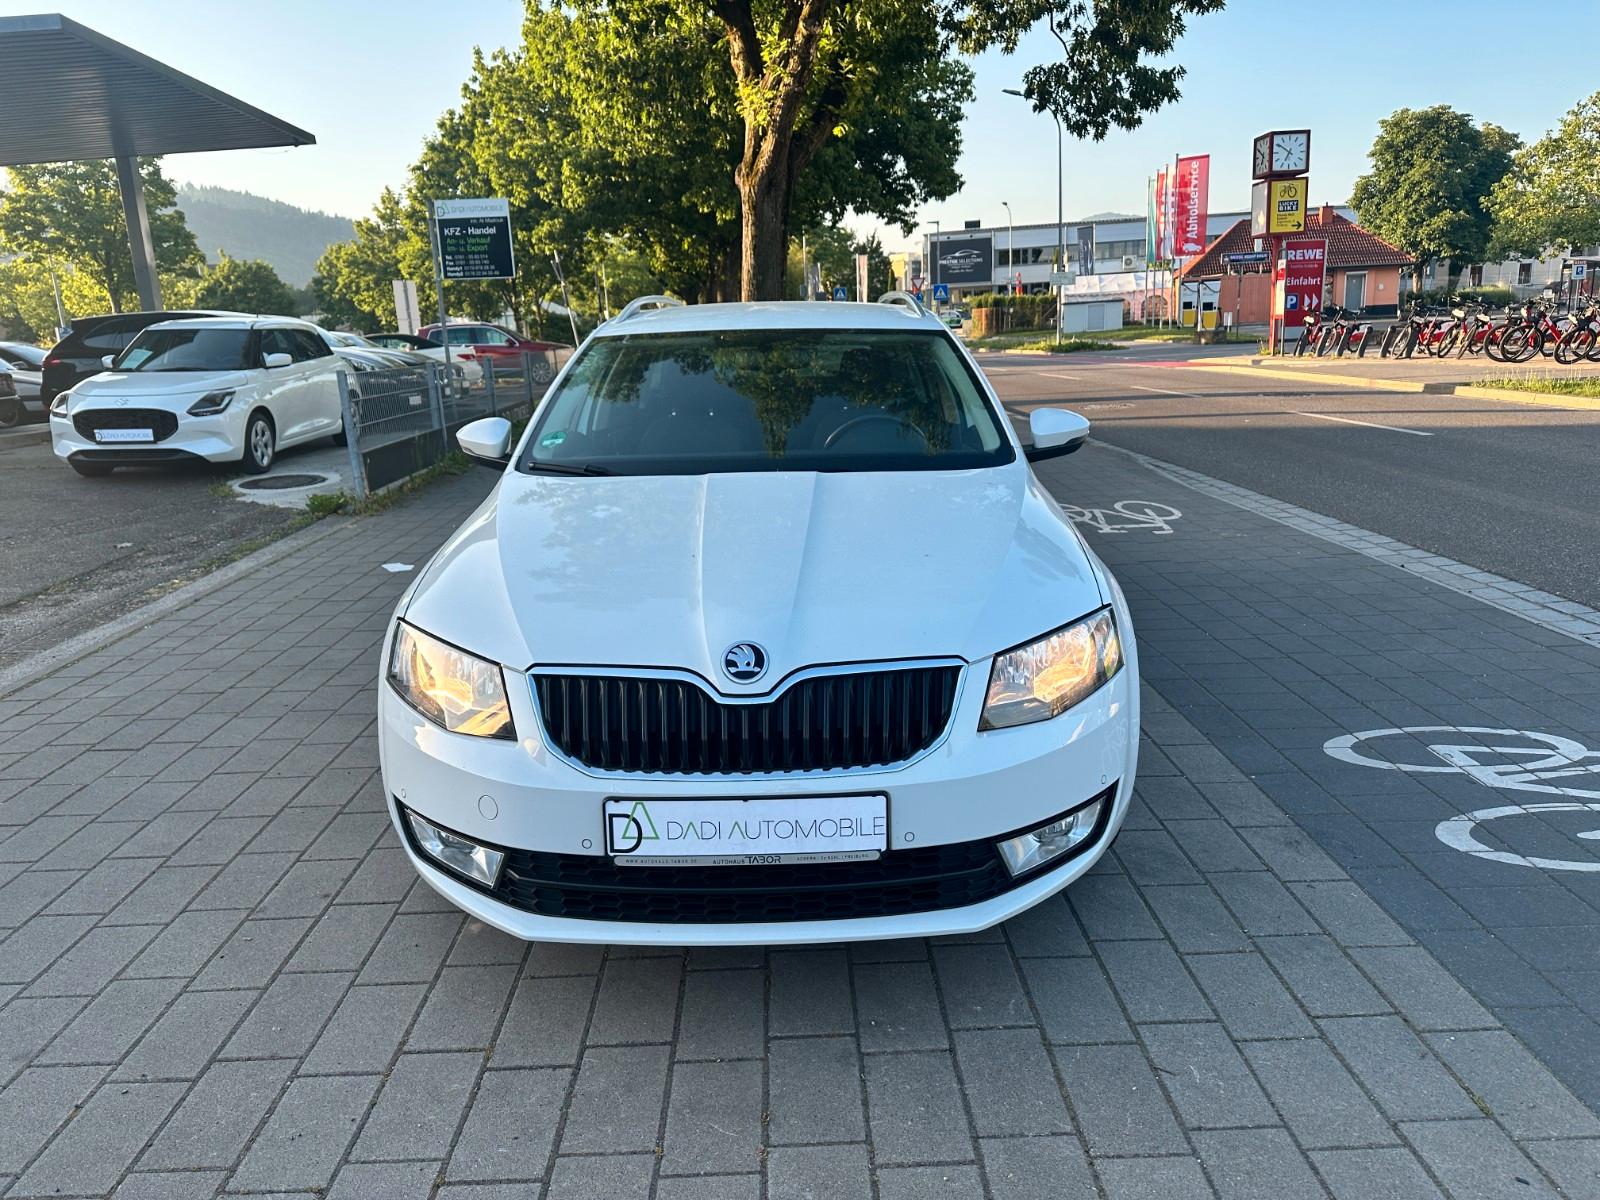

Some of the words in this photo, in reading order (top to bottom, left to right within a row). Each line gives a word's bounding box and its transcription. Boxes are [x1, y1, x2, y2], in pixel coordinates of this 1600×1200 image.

[1186, 160, 1199, 239] Abholservice
[444, 227, 461, 236] KFZ
[468, 226, 496, 235] Handel
[1287, 249, 1323, 260] REWE
[1286, 276, 1320, 286] Einfahrt
[1286, 295, 1296, 308] P
[666, 821, 721, 840] DADI
[728, 816, 886, 840] AUTOMOBILE
[744, 855, 782, 864] TABOR
